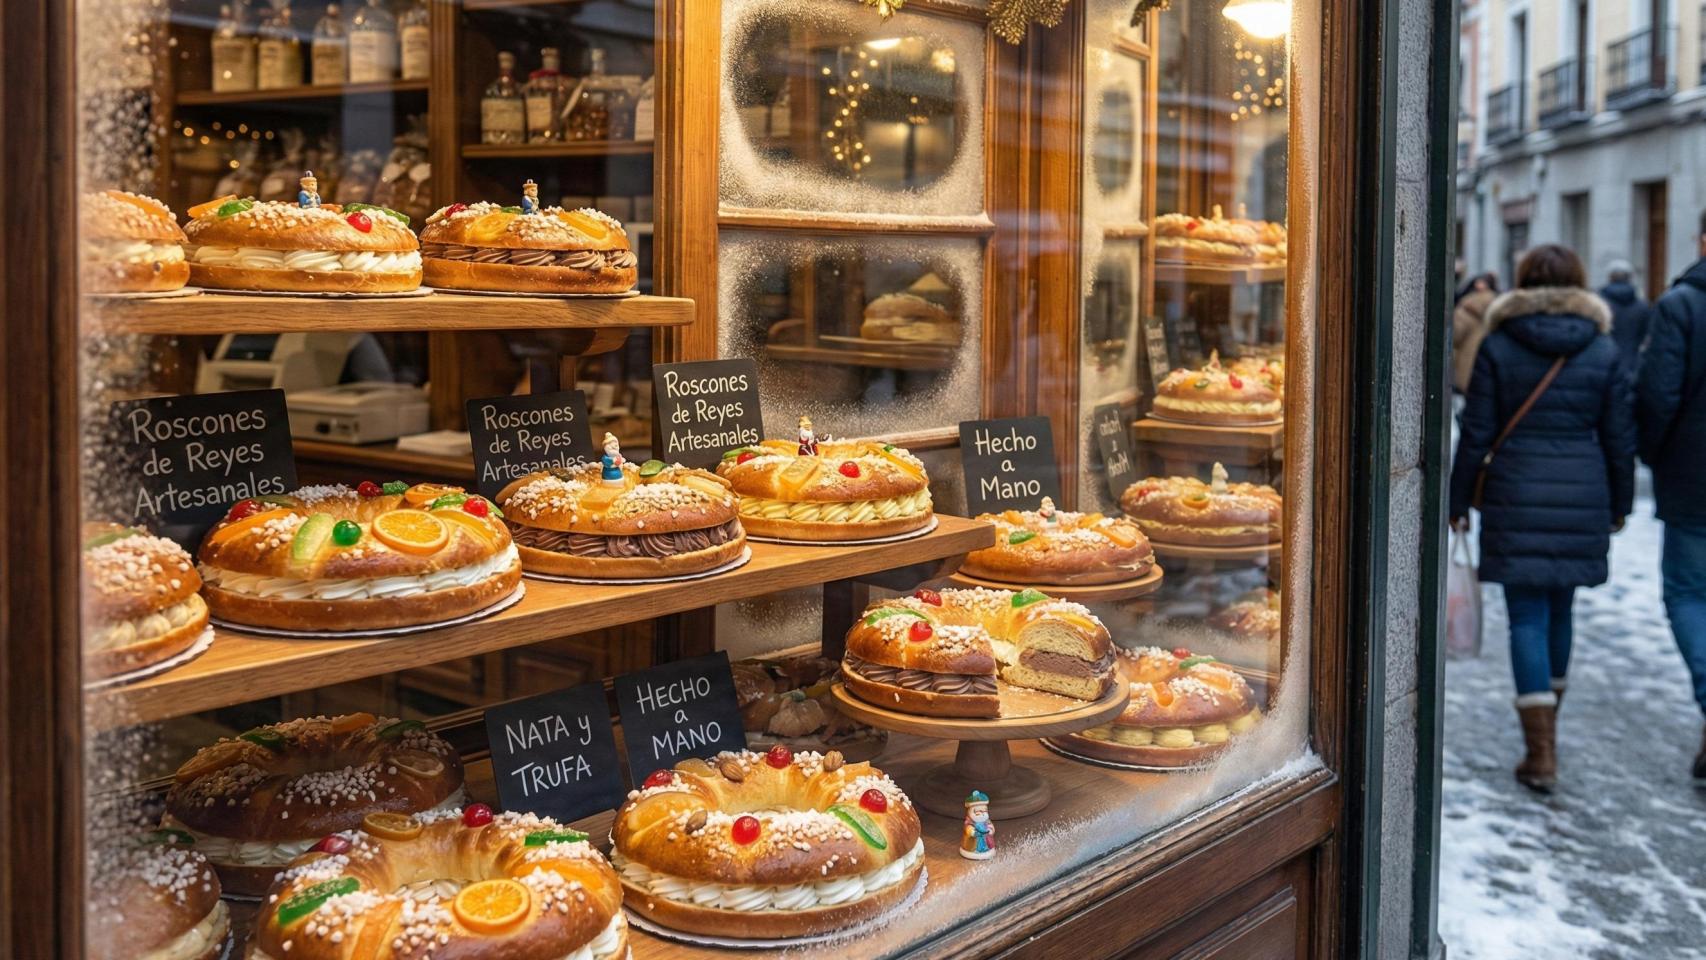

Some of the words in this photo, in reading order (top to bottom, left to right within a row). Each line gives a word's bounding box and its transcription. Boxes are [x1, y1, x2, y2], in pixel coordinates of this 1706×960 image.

[663, 371, 748, 398] Roscones
[128, 408, 267, 444] Roscones
[481, 405, 574, 430] Roscones
[671, 404, 691, 424] de
[695, 399, 744, 426] Reyes
[489, 432, 511, 454] de
[517, 428, 572, 455] Reyes
[668, 424, 759, 453] Artesanales
[974, 427, 1037, 455] Hecho
[142, 448, 174, 477] de
[185, 441, 265, 477] Reyes
[482, 450, 586, 482] Artesanales
[1001, 458, 1015, 472] a
[134, 472, 286, 518] Artesanales
[980, 475, 1041, 501] Mano
[636, 676, 711, 714] HECHO
[674, 709, 689, 724] a
[505, 715, 570, 754] NATA
[578, 714, 592, 746] y
[652, 721, 722, 760] MANO
[511, 754, 593, 797] TRUFA
